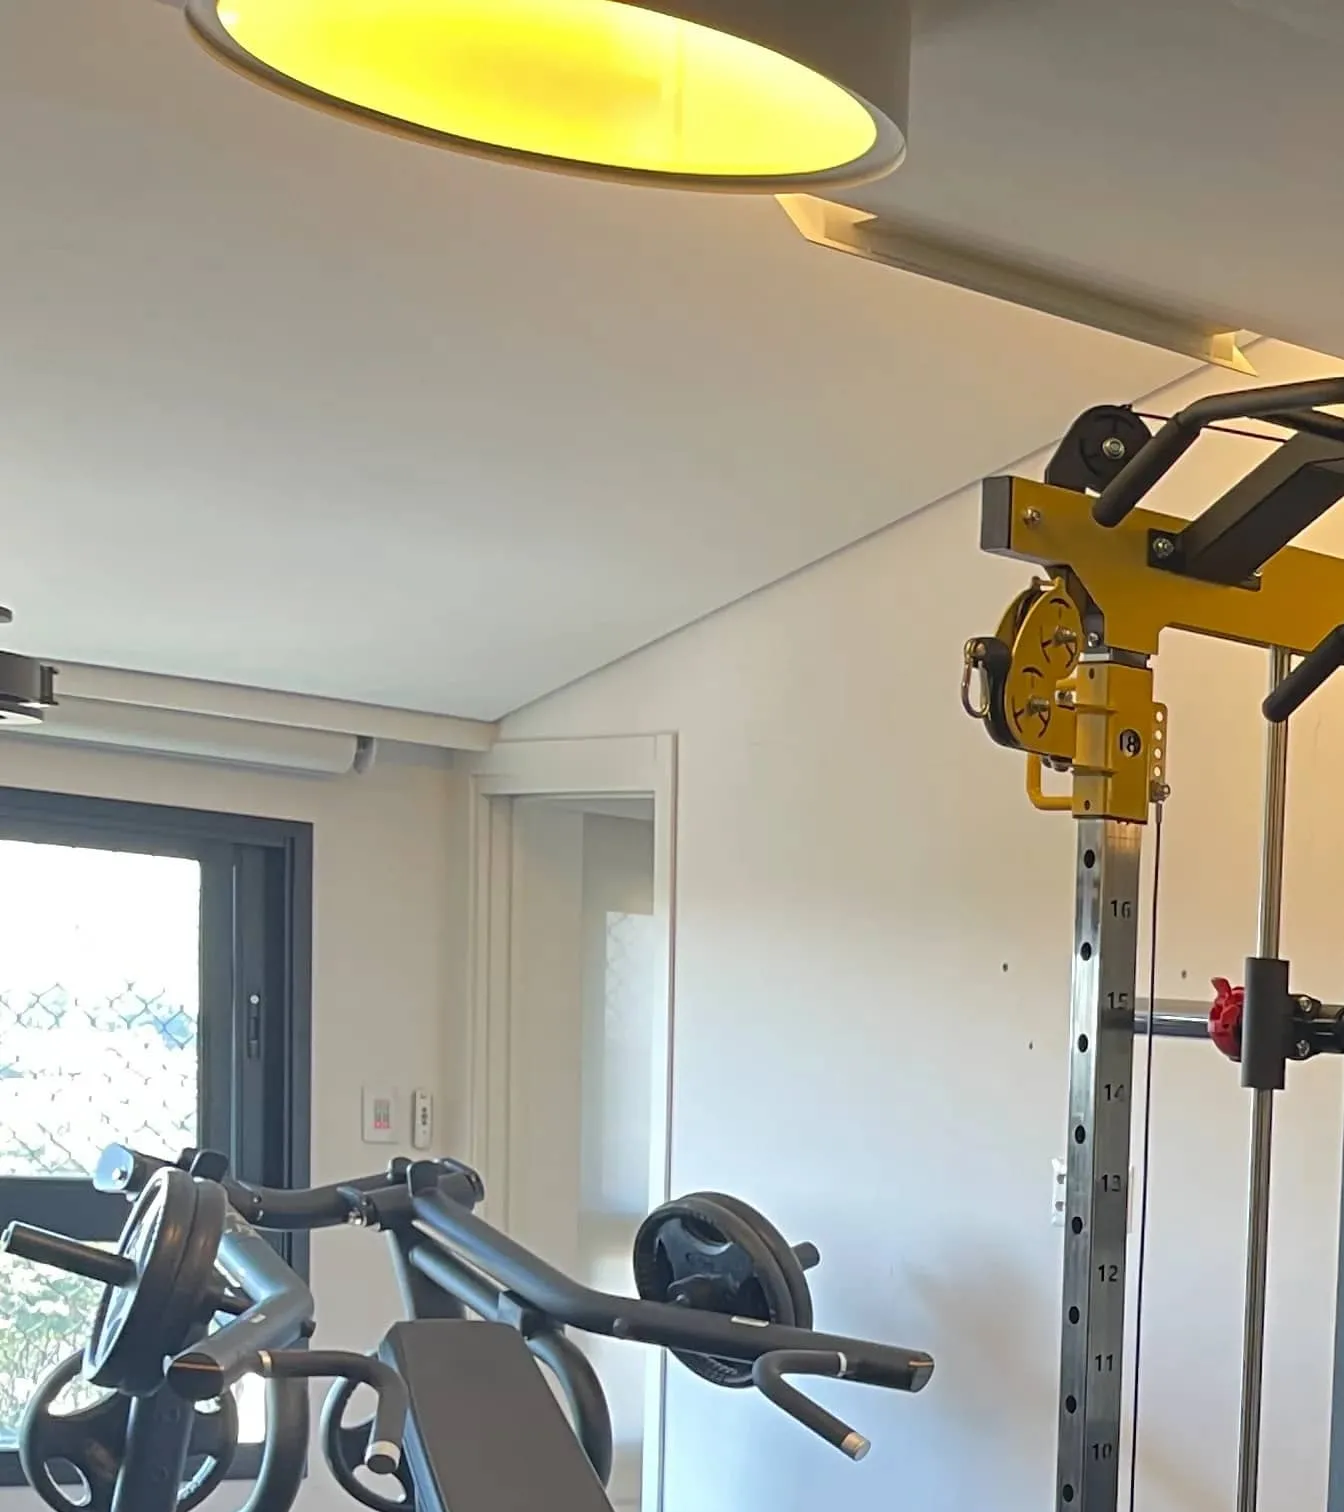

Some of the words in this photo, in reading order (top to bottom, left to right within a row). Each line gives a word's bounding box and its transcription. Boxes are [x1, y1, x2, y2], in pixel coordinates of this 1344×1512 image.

[1110, 900, 1131, 919] 16
[1107, 991, 1130, 1010] 15
[1104, 1084, 1125, 1103] 14
[1100, 1174, 1122, 1193] 13
[1097, 1264, 1119, 1283] 12
[1094, 1354, 1114, 1372] 11
[1091, 1443, 1112, 1461] 10
